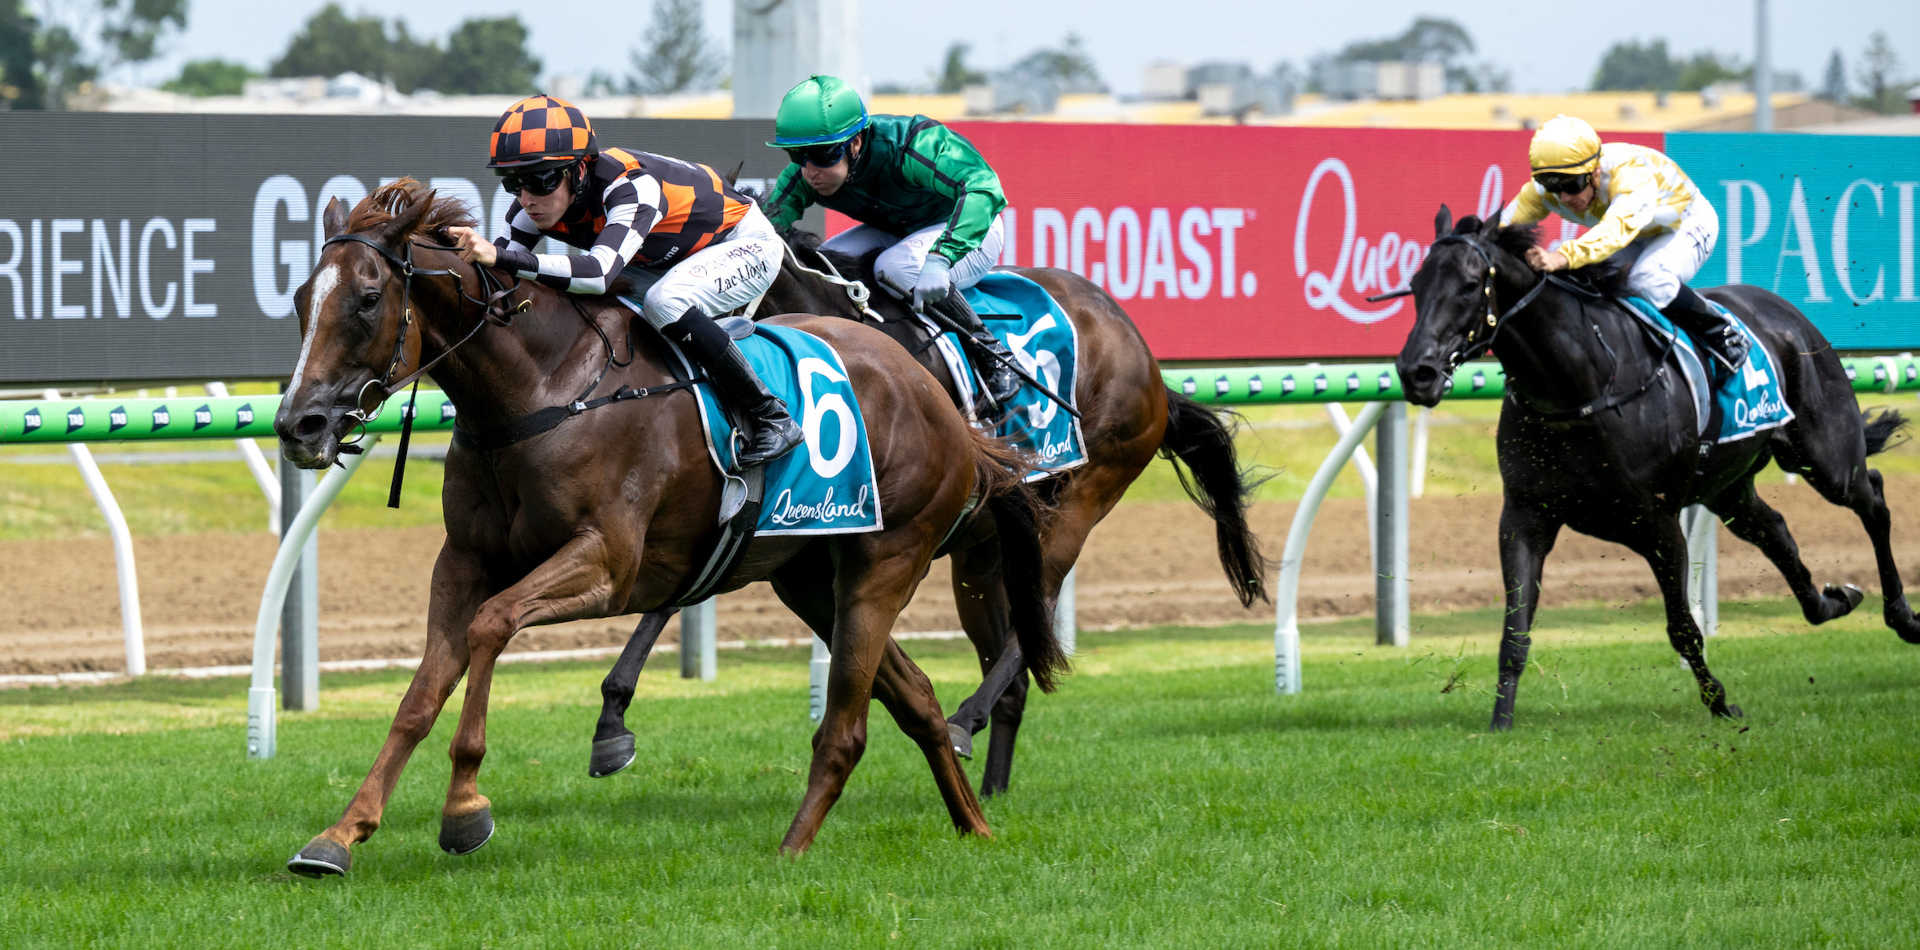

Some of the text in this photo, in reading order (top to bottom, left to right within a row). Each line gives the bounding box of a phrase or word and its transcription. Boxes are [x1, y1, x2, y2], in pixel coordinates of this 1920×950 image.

[714, 275, 737, 294] Zac
[1006, 313, 1061, 429] 5
[25, 414, 41, 427] TAB
[68, 414, 84, 426] TAB
[110, 413, 127, 425] TAB
[153, 412, 169, 424] TAB
[195, 411, 211, 423] TAB
[237, 410, 253, 422] TAB
[797, 357, 858, 478] 6
[771, 484, 868, 526] Queensland
